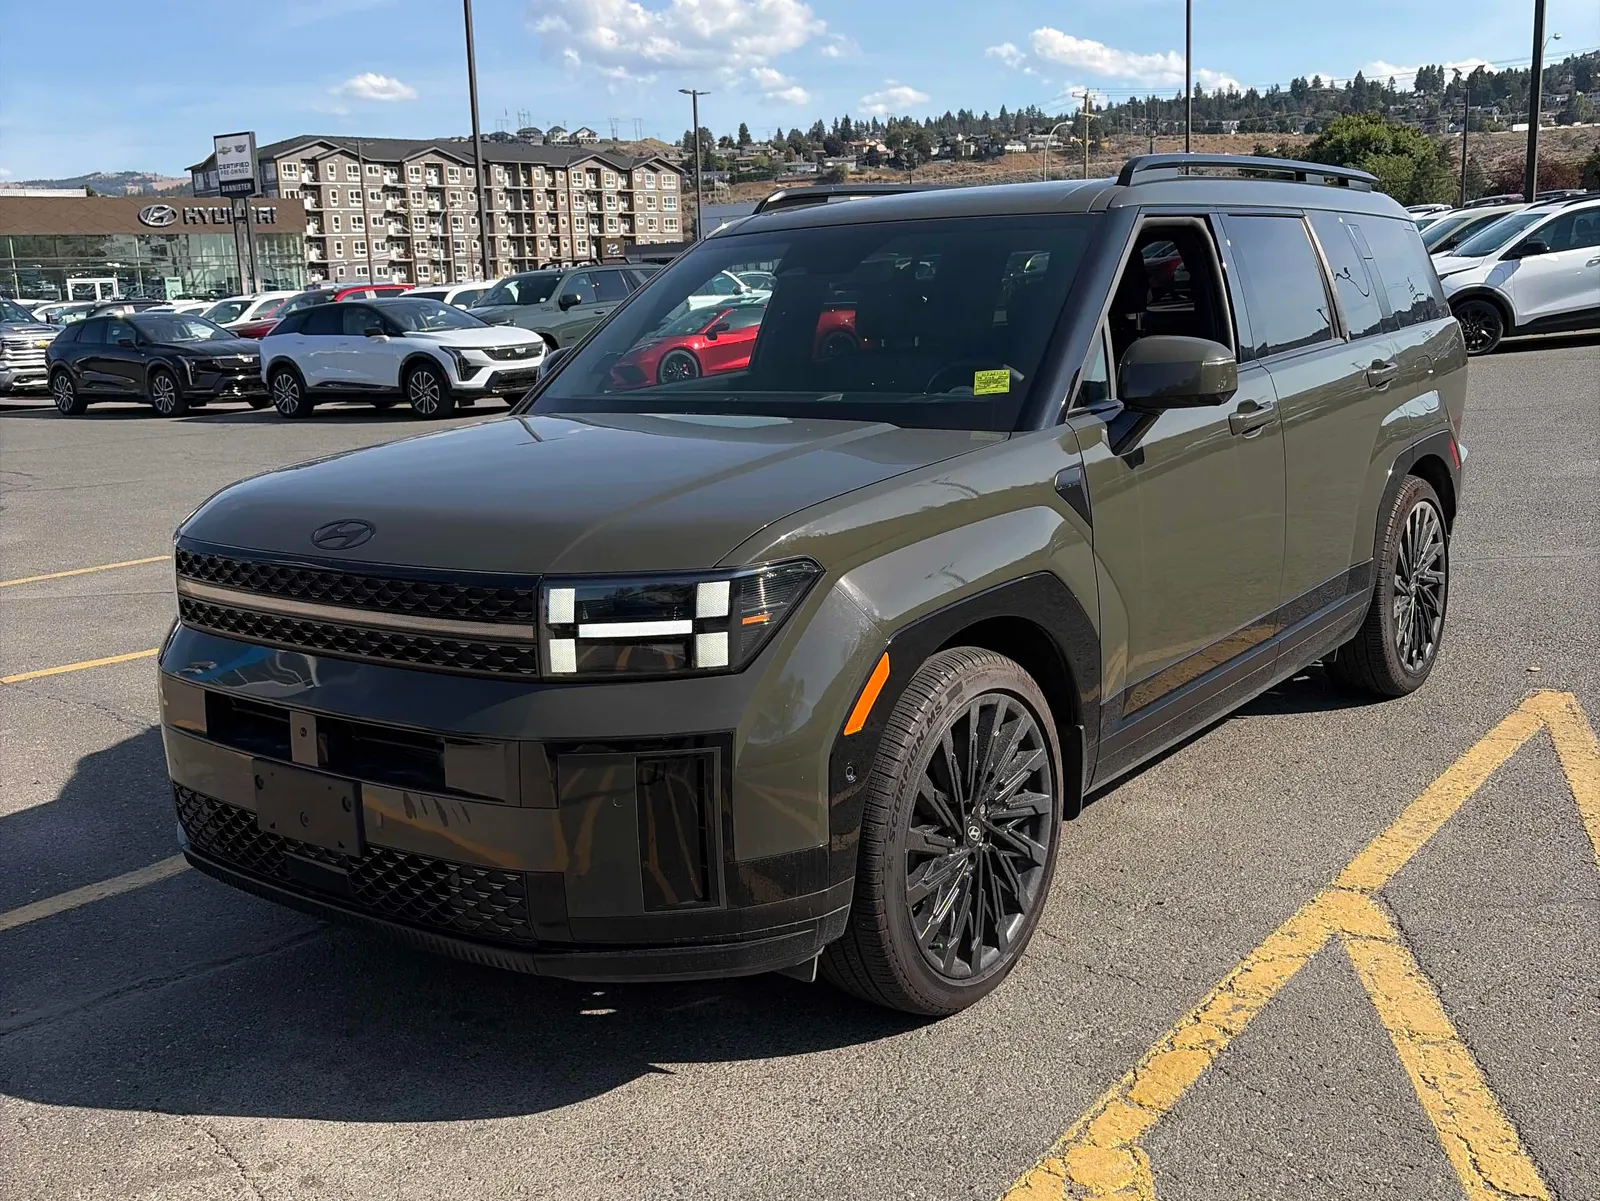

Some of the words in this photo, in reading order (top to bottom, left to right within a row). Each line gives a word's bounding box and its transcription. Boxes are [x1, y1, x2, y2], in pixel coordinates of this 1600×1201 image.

[218, 161, 250, 170] CERTIFIED
[220, 167, 249, 176] PRE-OWNED
[221, 183, 251, 193] BANNISTER
[889, 728, 926, 844] SCORPION
[926, 700, 943, 729] MS
